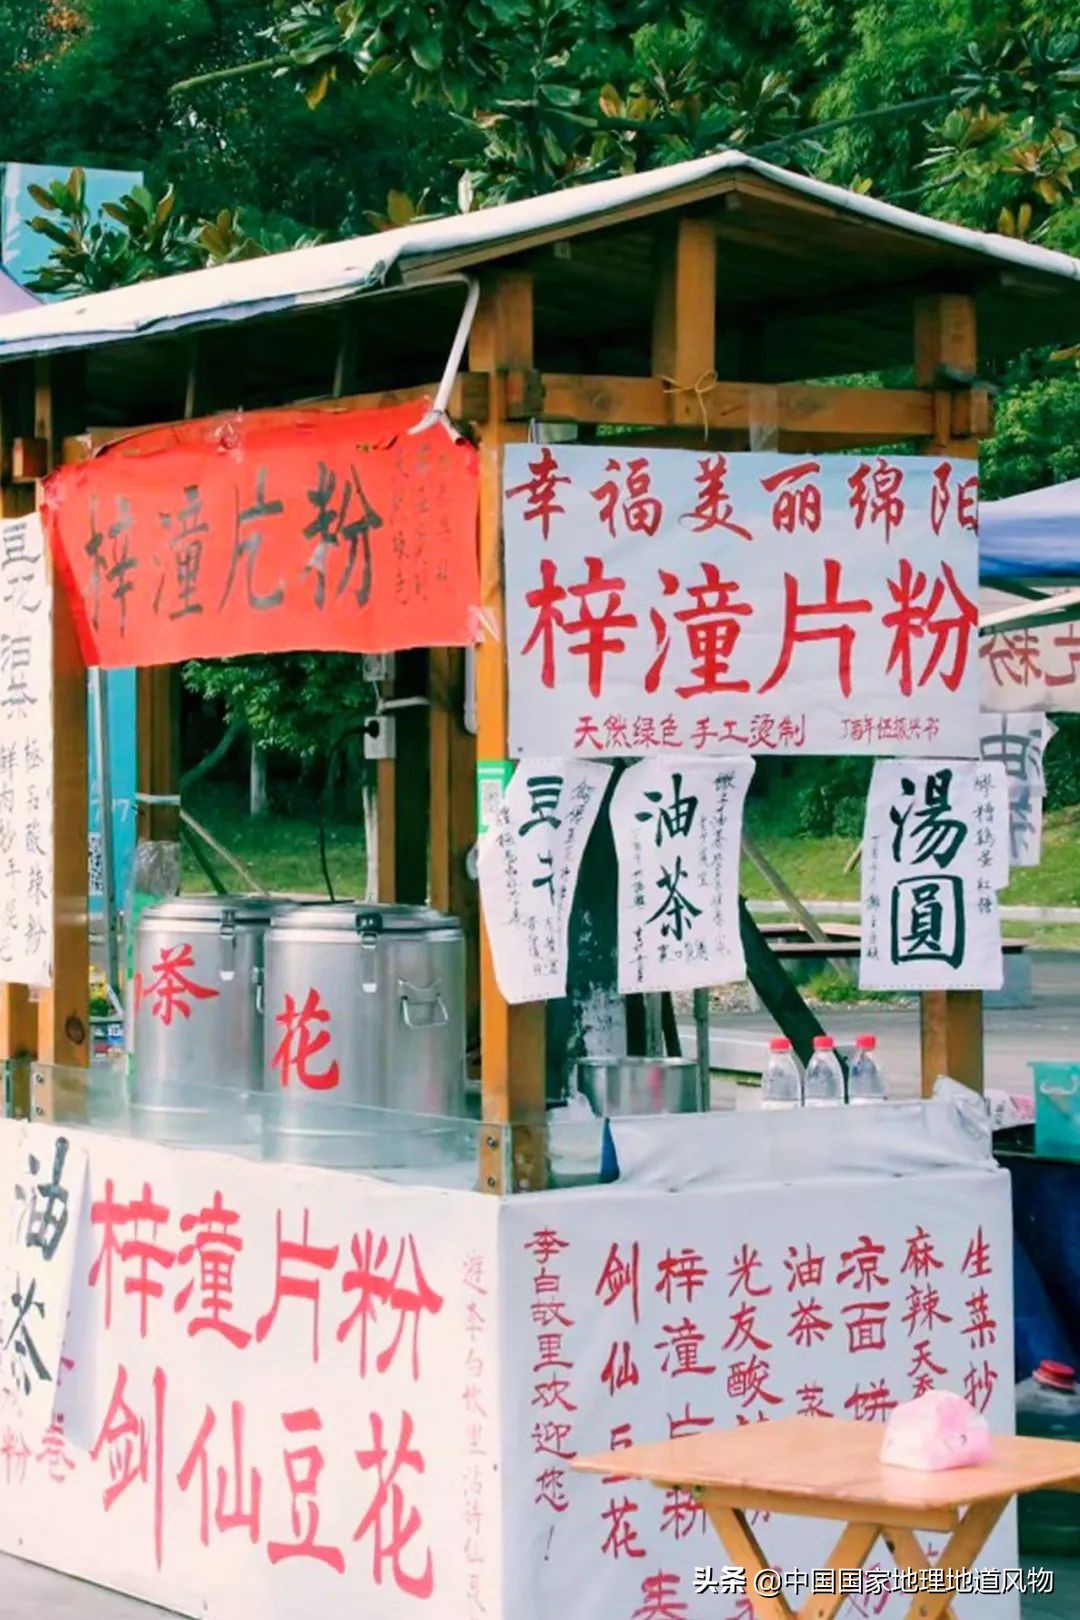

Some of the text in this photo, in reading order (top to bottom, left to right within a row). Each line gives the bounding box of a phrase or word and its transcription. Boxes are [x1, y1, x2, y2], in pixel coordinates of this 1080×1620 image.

[85, 459, 384, 640] 梓潼片粉
[504, 447, 979, 543] 幸福美丽绵阳
[521, 556, 980, 700] 梓潼片粉
[573, 714, 683, 751] 天然绿色
[690, 713, 806, 750] 手工烫制
[633, 772, 703, 942] 油茶
[890, 768, 968, 971] 湯圓
[269, 986, 341, 1092] 花
[88, 1177, 444, 1383] 梓潼片粉
[783, 1242, 834, 1348] 油茶
[836, 1235, 890, 1354] 凉面
[91, 1363, 434, 1600] 剑仙豆花
